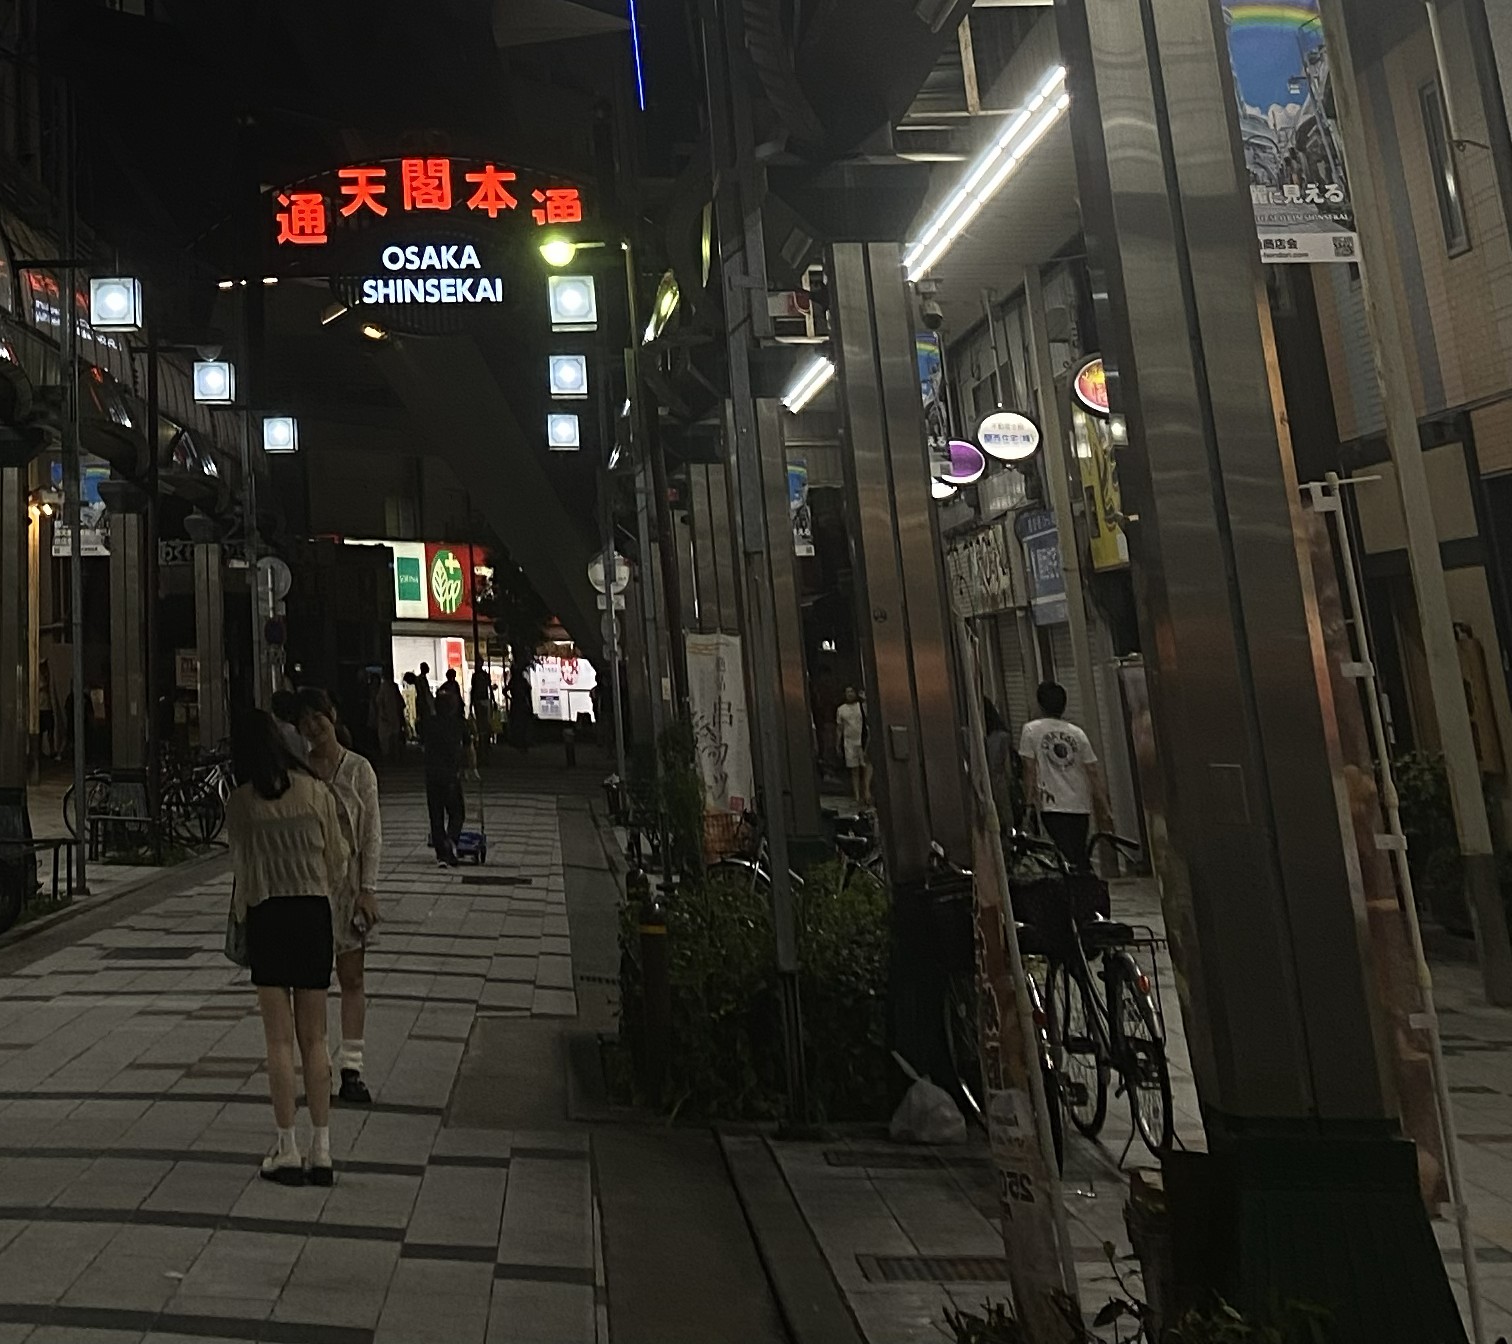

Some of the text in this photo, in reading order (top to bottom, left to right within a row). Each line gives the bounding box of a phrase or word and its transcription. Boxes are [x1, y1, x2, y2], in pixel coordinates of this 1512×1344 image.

[276, 158, 582, 245] 通天閣本通
[1260, 237, 1298, 250] 商店会
[382, 244, 481, 270] OSAKA
[362, 277, 503, 303] SHINSEKAI
